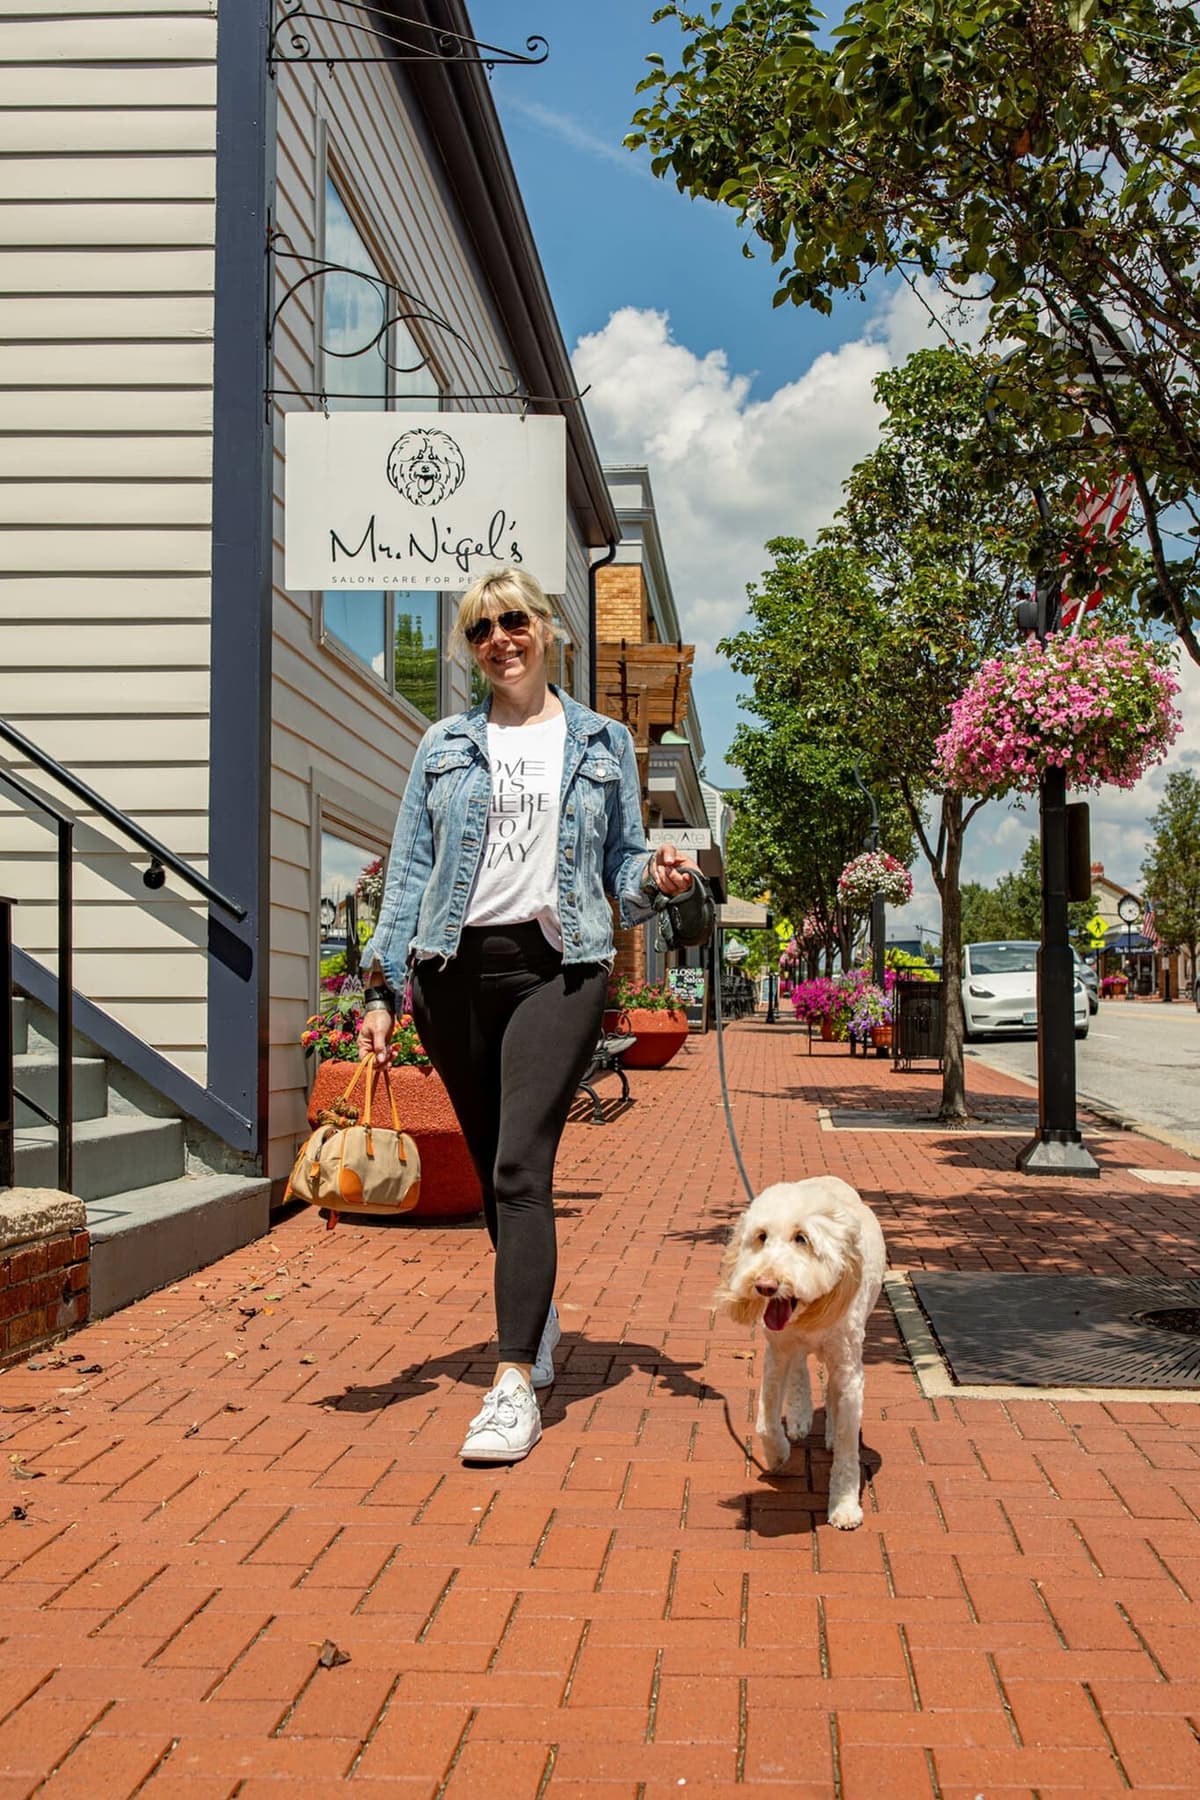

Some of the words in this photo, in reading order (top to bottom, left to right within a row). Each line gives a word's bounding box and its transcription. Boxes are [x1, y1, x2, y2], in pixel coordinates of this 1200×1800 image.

[329, 515, 402, 562] Mr.
[409, 510, 523, 573] Nigel's
[331, 576, 375, 584] SALON
[382, 576, 417, 584] CARE
[425, 576, 450, 584] FOR
[458, 576, 475, 584] PE
[495, 757, 547, 778] VE
[499, 777, 525, 793] IS
[488, 835, 540, 870] TAY
